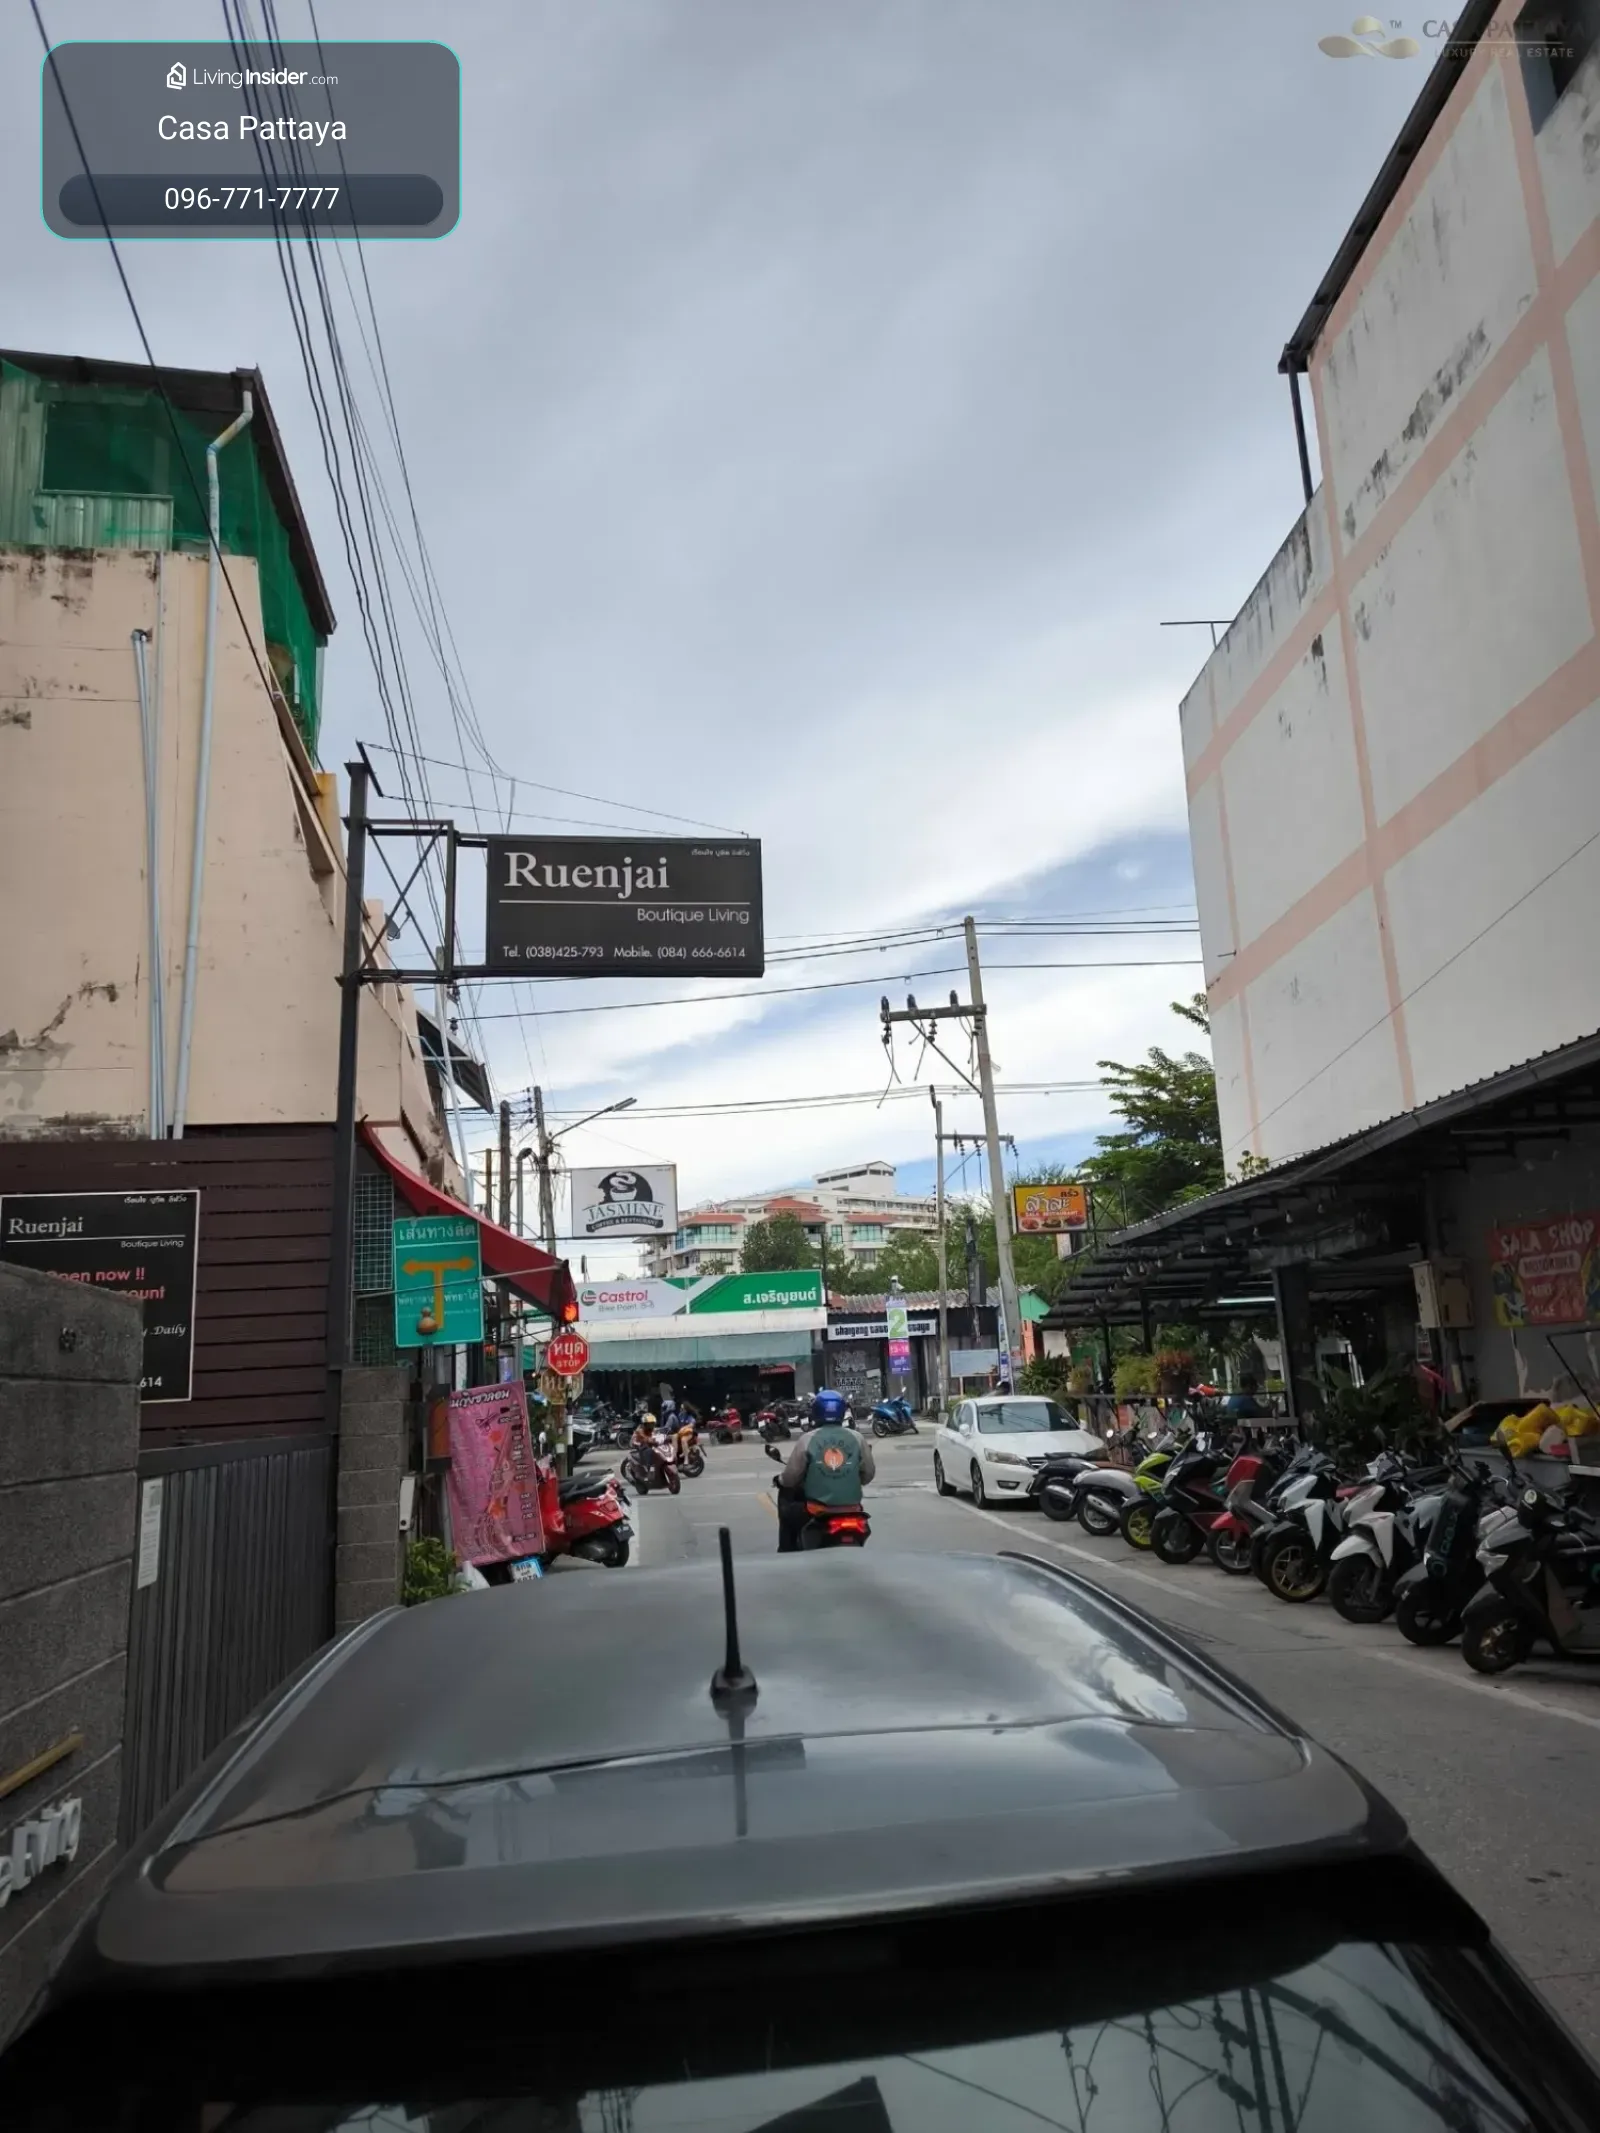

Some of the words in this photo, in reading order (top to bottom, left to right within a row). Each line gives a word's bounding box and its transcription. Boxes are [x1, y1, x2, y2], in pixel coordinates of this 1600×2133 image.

[504, 852, 669, 899] Ruenjai
[637, 908, 704, 923] Boutique
[708, 908, 750, 924] Living
[504, 946, 521, 958] Tel.
[526, 946, 604, 959] (038)425-793
[657, 946, 687, 959] (084)
[691, 946, 746, 958] 666-6614
[588, 1203, 664, 1222] JASMINE
[8, 1217, 84, 1237] Ruenjai
[121, 1240, 158, 1248] Boutique
[160, 1239, 184, 1248] Living
[1501, 1231, 1541, 1257] SALA
[1548, 1220, 1594, 1251] SHOP
[95, 1269, 130, 1281] now
[136, 1267, 145, 1280] !!
[120, 1286, 166, 1299] ount
[599, 1290, 648, 1303] Castrol
[743, 1287, 817, 1305] ส.เจริญยนต์
[151, 1324, 185, 1336] Daily
[870, 1325, 888, 1334] tatt
[908, 1323, 930, 1333] ttaya
[889, 1308, 908, 1337] 2
[554, 1341, 584, 1359] หยุด
[140, 1376, 162, 1388] 614
